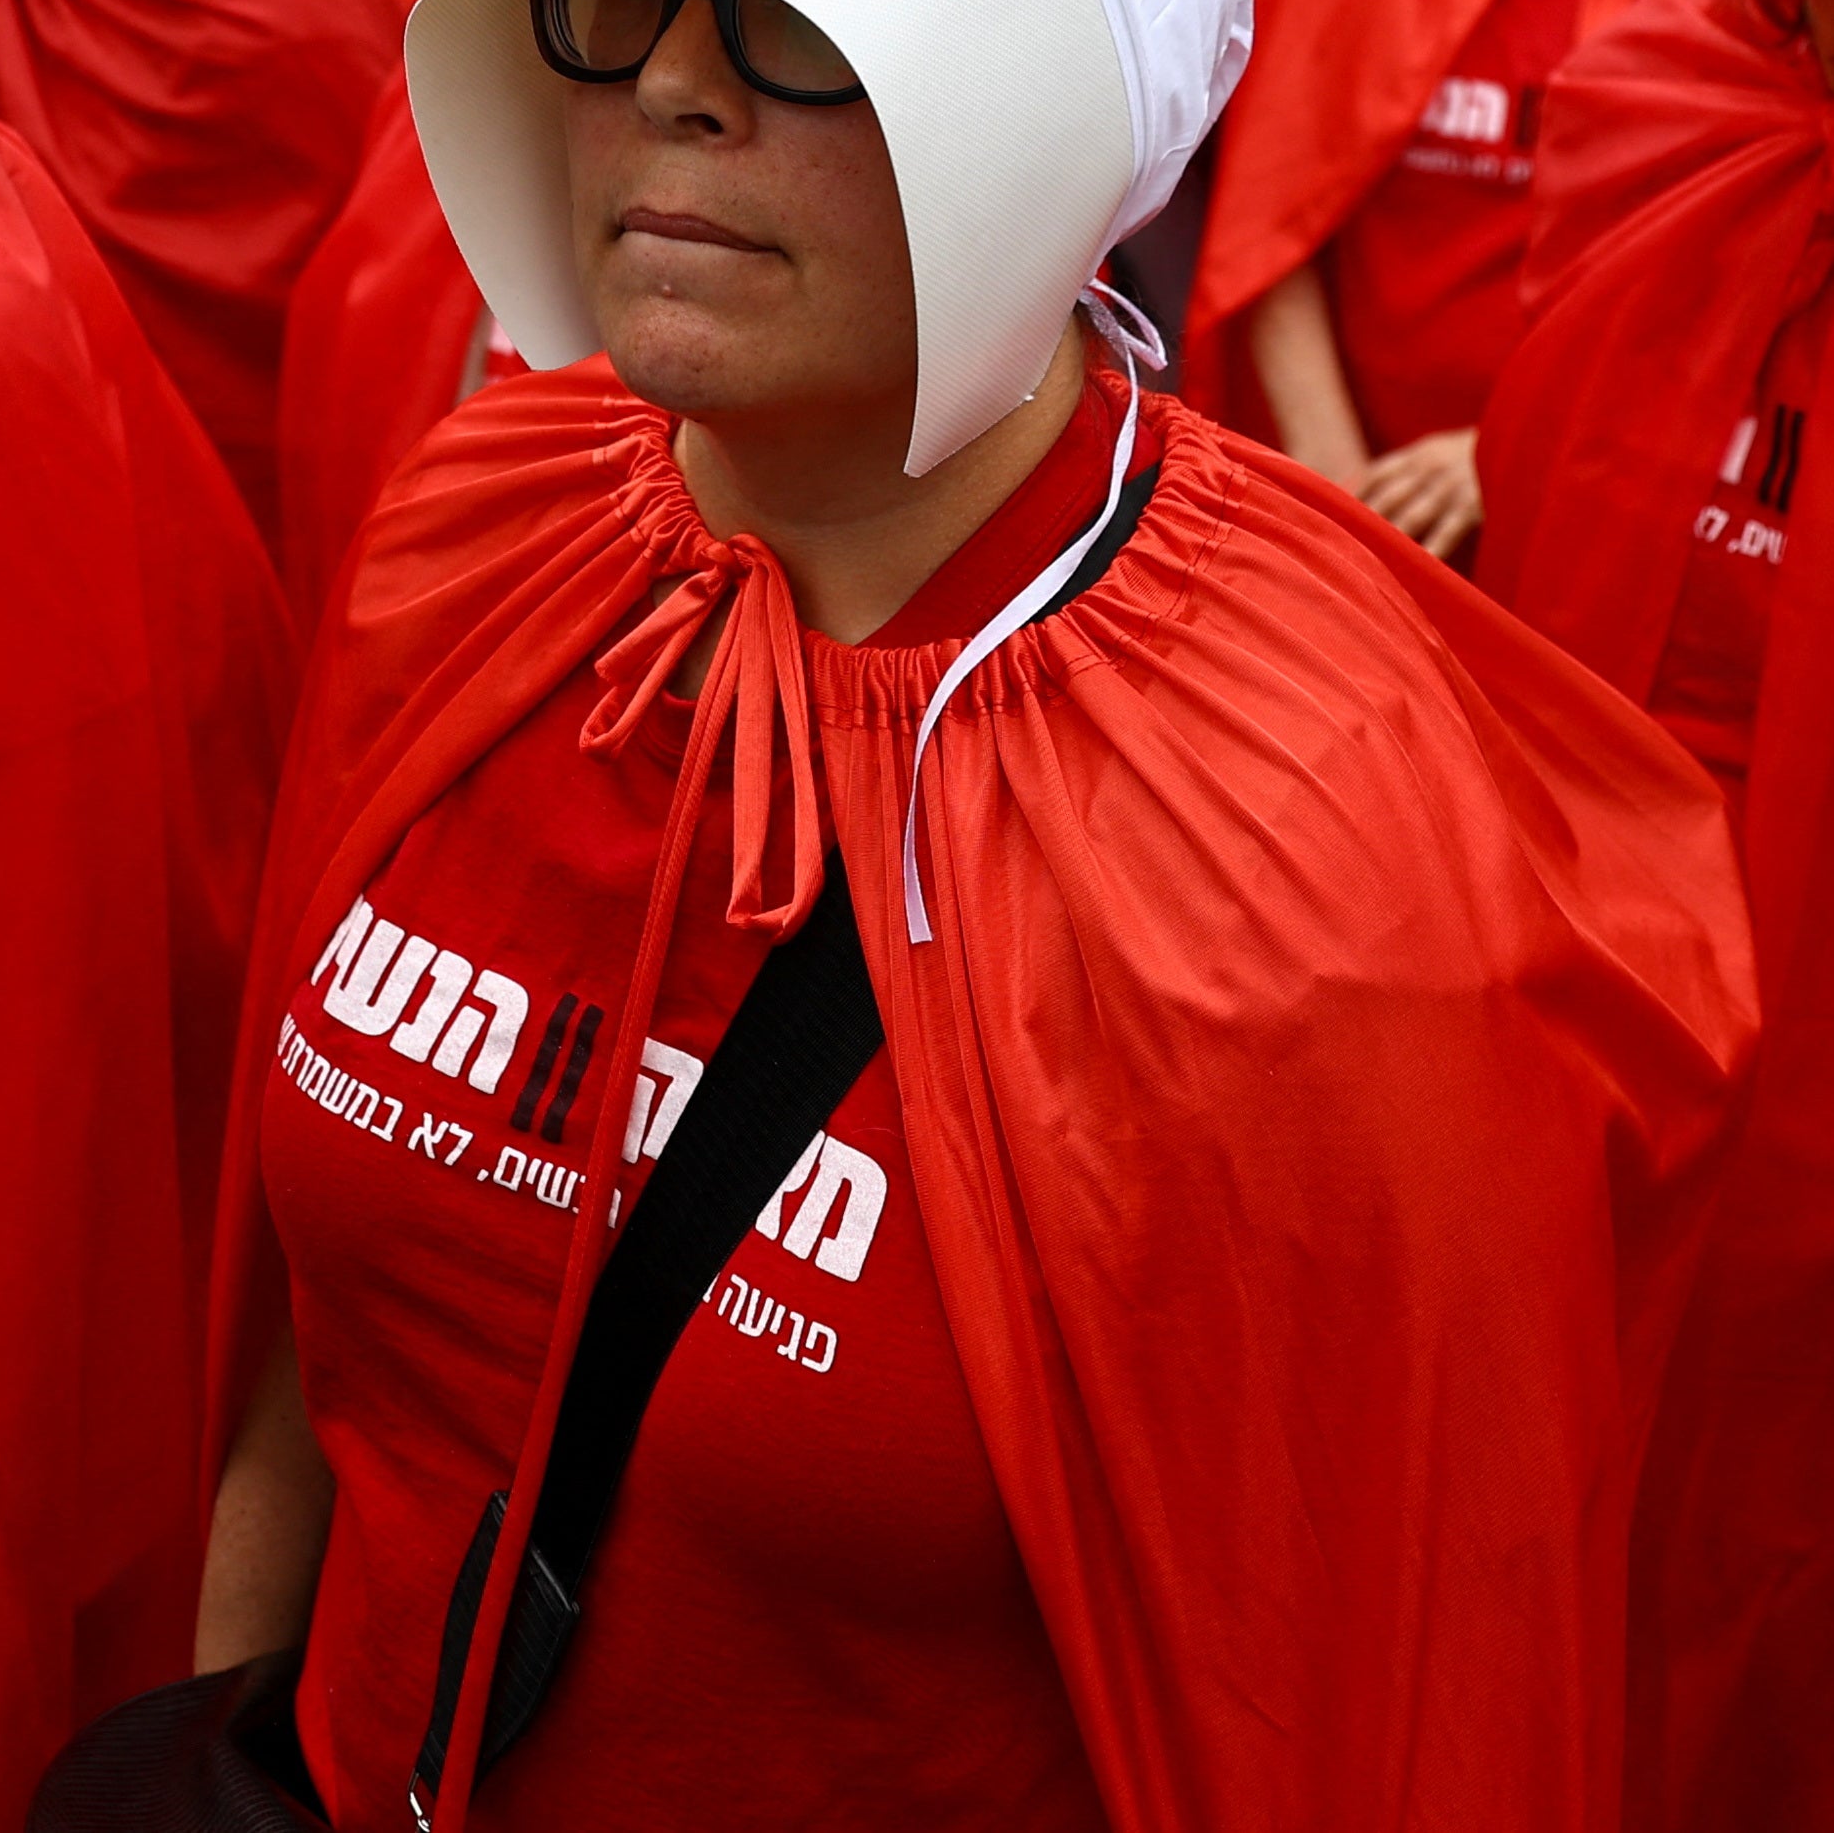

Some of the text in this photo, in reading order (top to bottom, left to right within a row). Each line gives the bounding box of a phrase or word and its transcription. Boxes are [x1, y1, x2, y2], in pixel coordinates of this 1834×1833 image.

[281, 1031, 404, 1143] במשמרת
[407, 1111, 474, 1167] לא
[477, 1145, 587, 1214] שים,
[621, 1036, 887, 1282] מק
[717, 1273, 837, 1373] פגיעה
